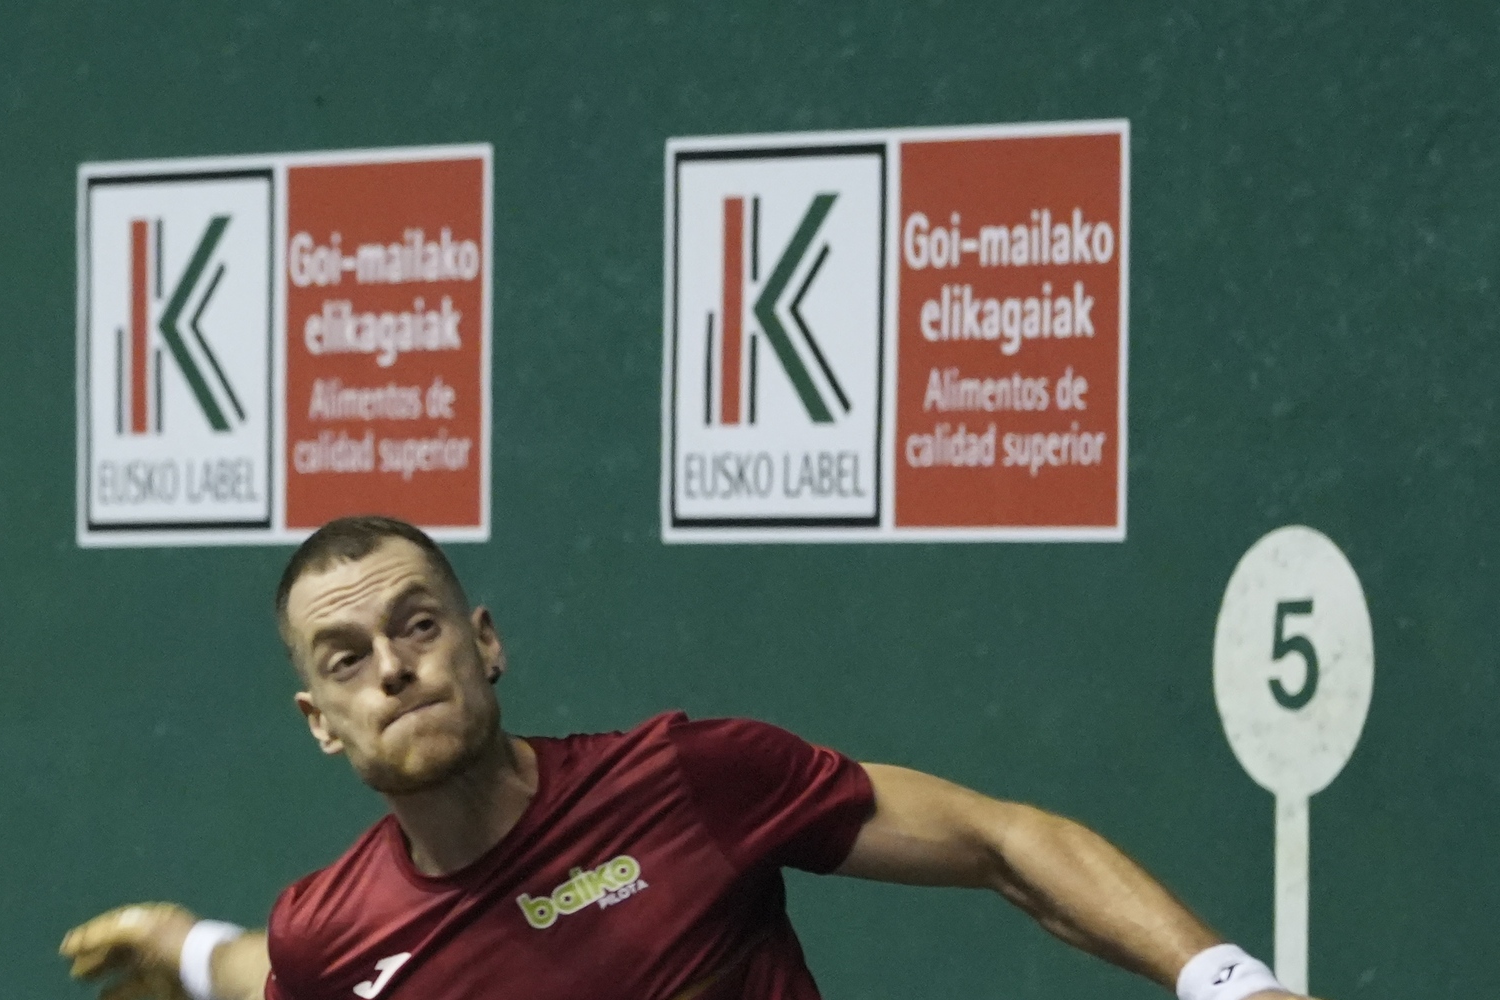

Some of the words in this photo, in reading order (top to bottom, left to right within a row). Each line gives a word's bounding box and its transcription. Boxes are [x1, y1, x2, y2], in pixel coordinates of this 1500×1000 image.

[288, 227, 479, 288] Goi-mailako
[903, 207, 1114, 271] Goi-mailako
[304, 295, 462, 368] elikagaiak
[920, 281, 1095, 356] elikagaiak
[309, 377, 421, 421] Alimentos
[426, 376, 455, 418] de
[923, 367, 1049, 414] Alimentos
[1056, 366, 1088, 411] de
[294, 429, 375, 475] calidad
[380, 427, 472, 481] superior
[684, 452, 774, 500] EUSKO
[783, 450, 866, 498] LABEL
[905, 422, 997, 470] calidad
[1003, 421, 1106, 478] superior
[100, 457, 180, 505] EUSKO
[185, 457, 259, 503] LABEL
[1268, 598, 1319, 712] 5
[516, 855, 641, 929] baiko
